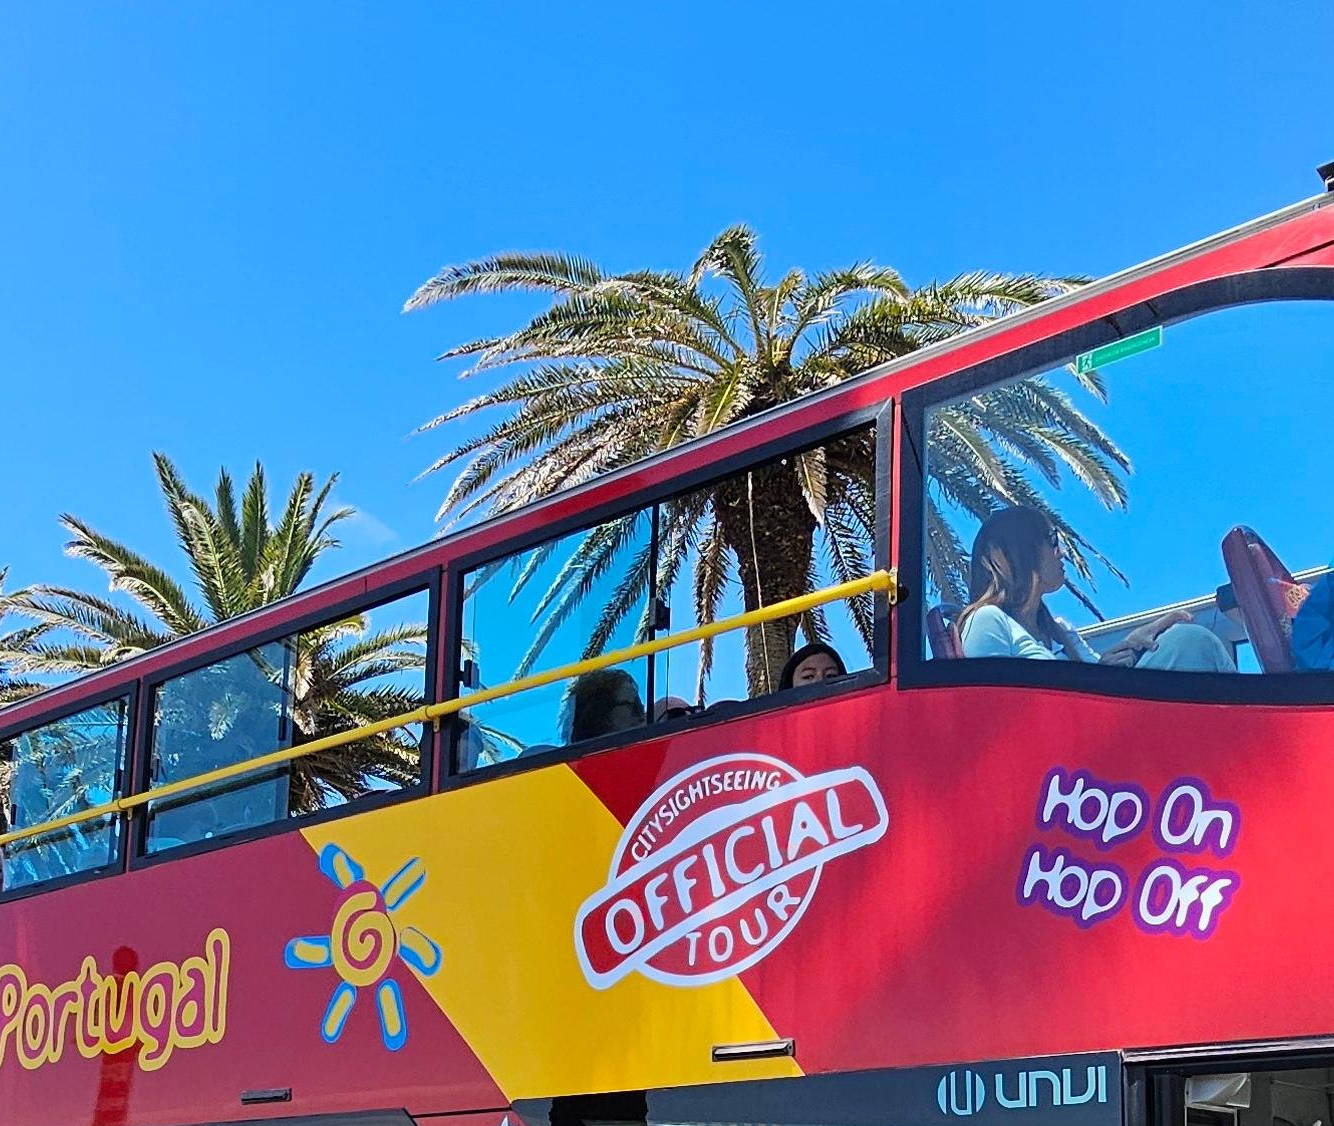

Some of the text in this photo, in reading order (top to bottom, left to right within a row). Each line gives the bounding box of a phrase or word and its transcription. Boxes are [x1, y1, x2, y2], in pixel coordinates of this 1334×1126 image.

[631, 769, 781, 862] CITYSIGHTSEEING
[1043, 775, 1232, 849] Hop On
[605, 788, 863, 954] OFFICIAL
[1023, 851, 1232, 931] Hop Off
[686, 883, 801, 966] TOUR
